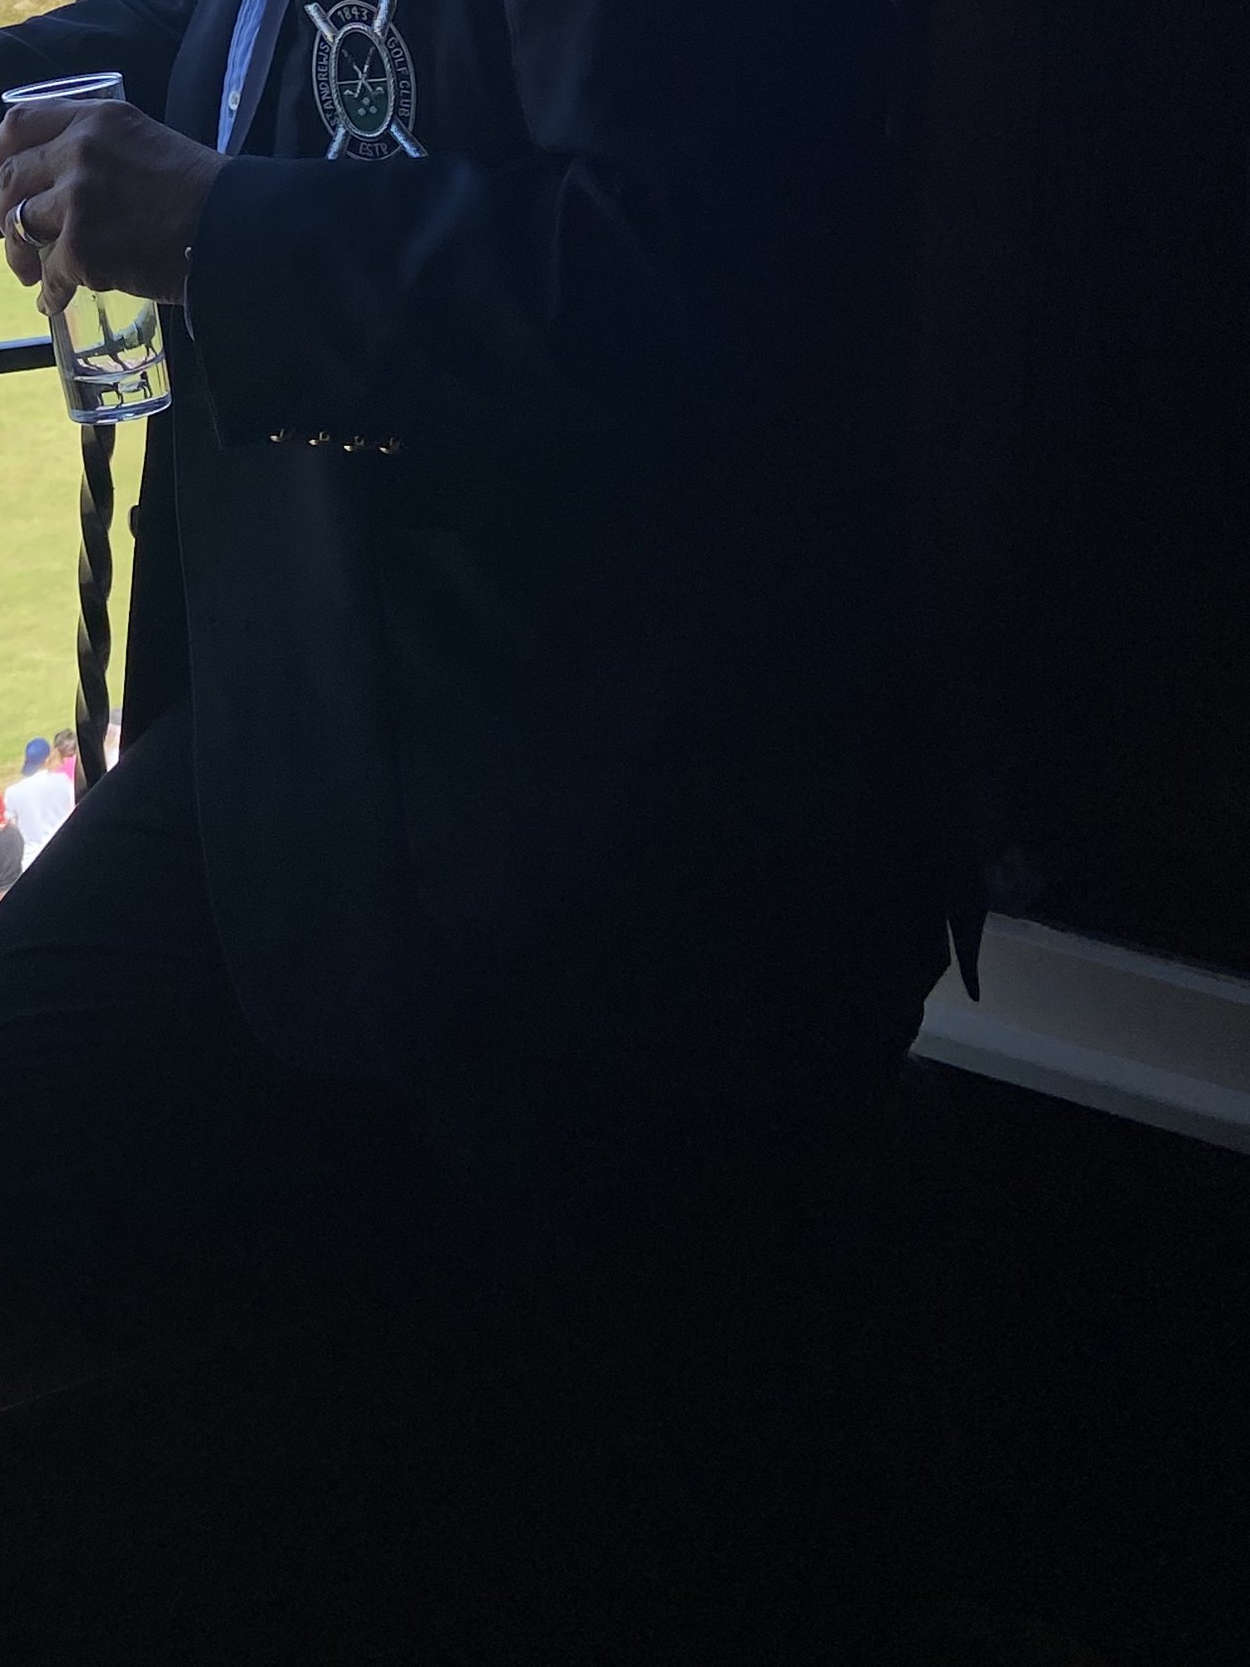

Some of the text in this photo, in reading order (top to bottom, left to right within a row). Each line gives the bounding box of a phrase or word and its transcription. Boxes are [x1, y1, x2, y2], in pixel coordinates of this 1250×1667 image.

[337, 5, 369, 22] 1843
[317, 41, 334, 110] ANDREWS
[385, 36, 412, 118] GOLF CLUB
